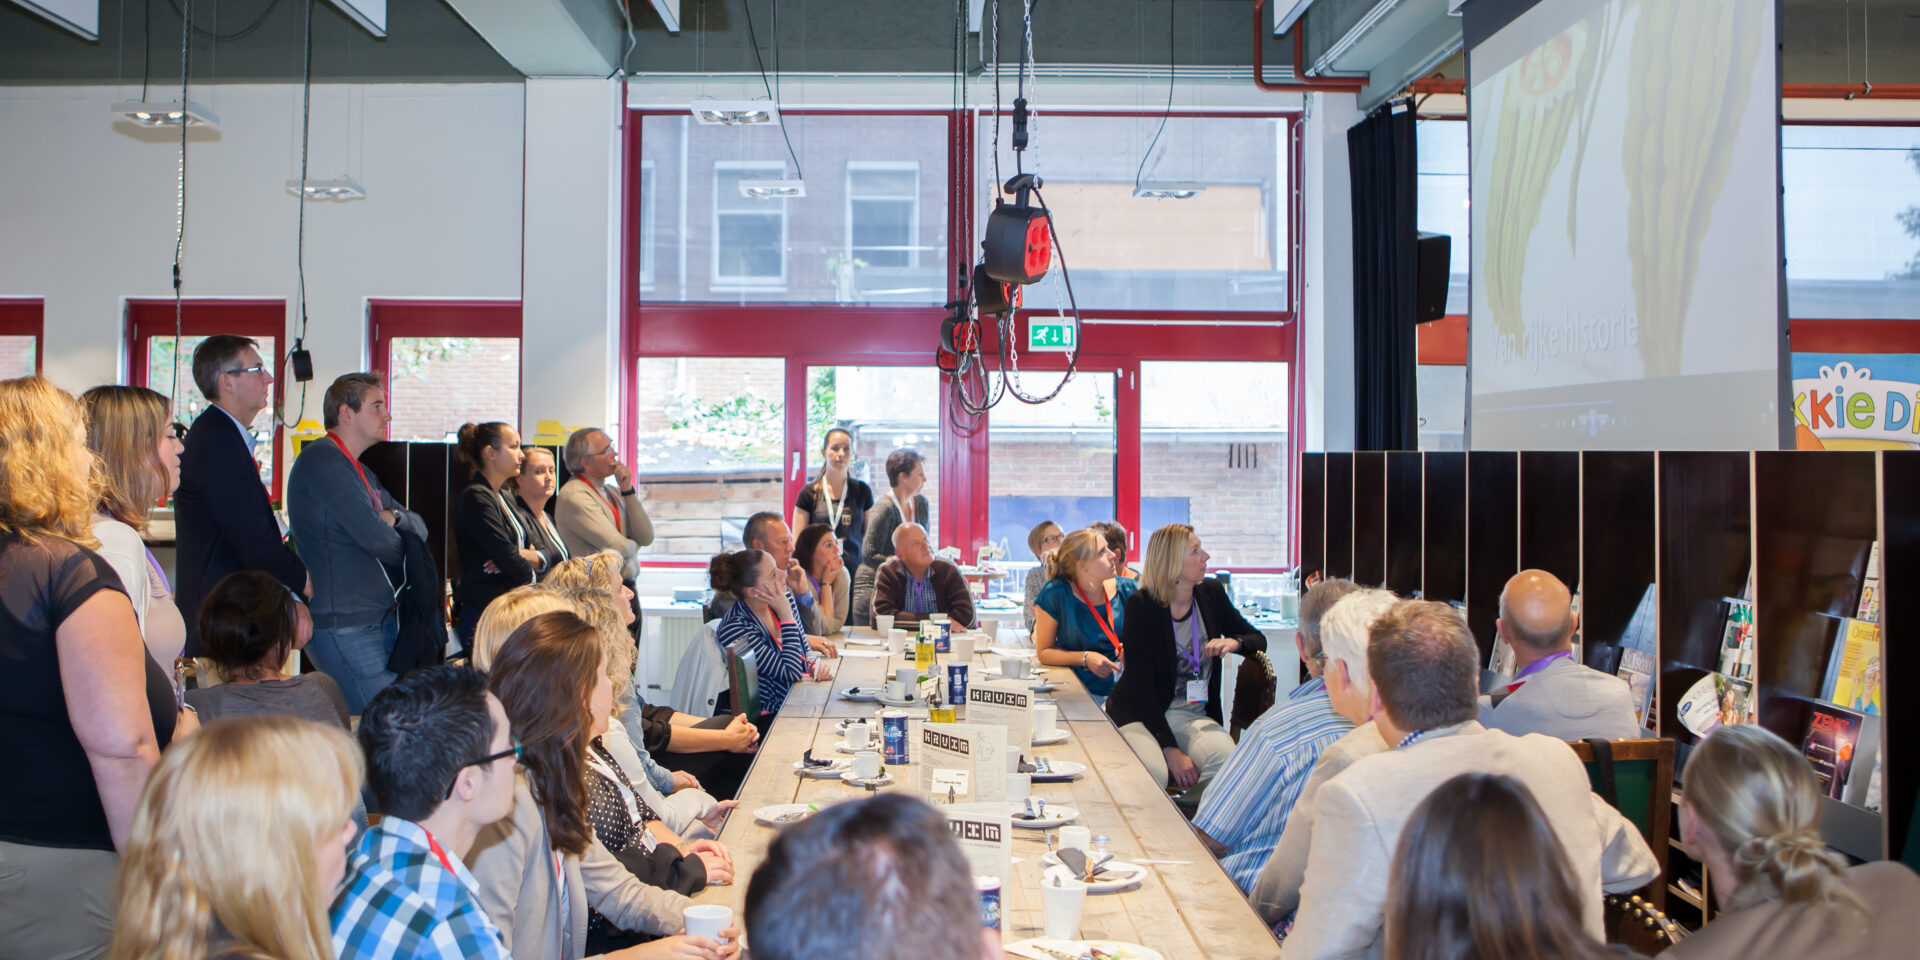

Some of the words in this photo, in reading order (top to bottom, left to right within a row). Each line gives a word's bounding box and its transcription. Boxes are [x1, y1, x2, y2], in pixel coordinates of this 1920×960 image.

[1489, 320, 1517, 364] Van
[1522, 312, 1560, 375] rijke
[1564, 303, 1639, 355] historie
[971, 689, 1027, 708] KRUIM
[923, 729, 969, 755] KRUIM
[947, 820, 1001, 842] UIM
